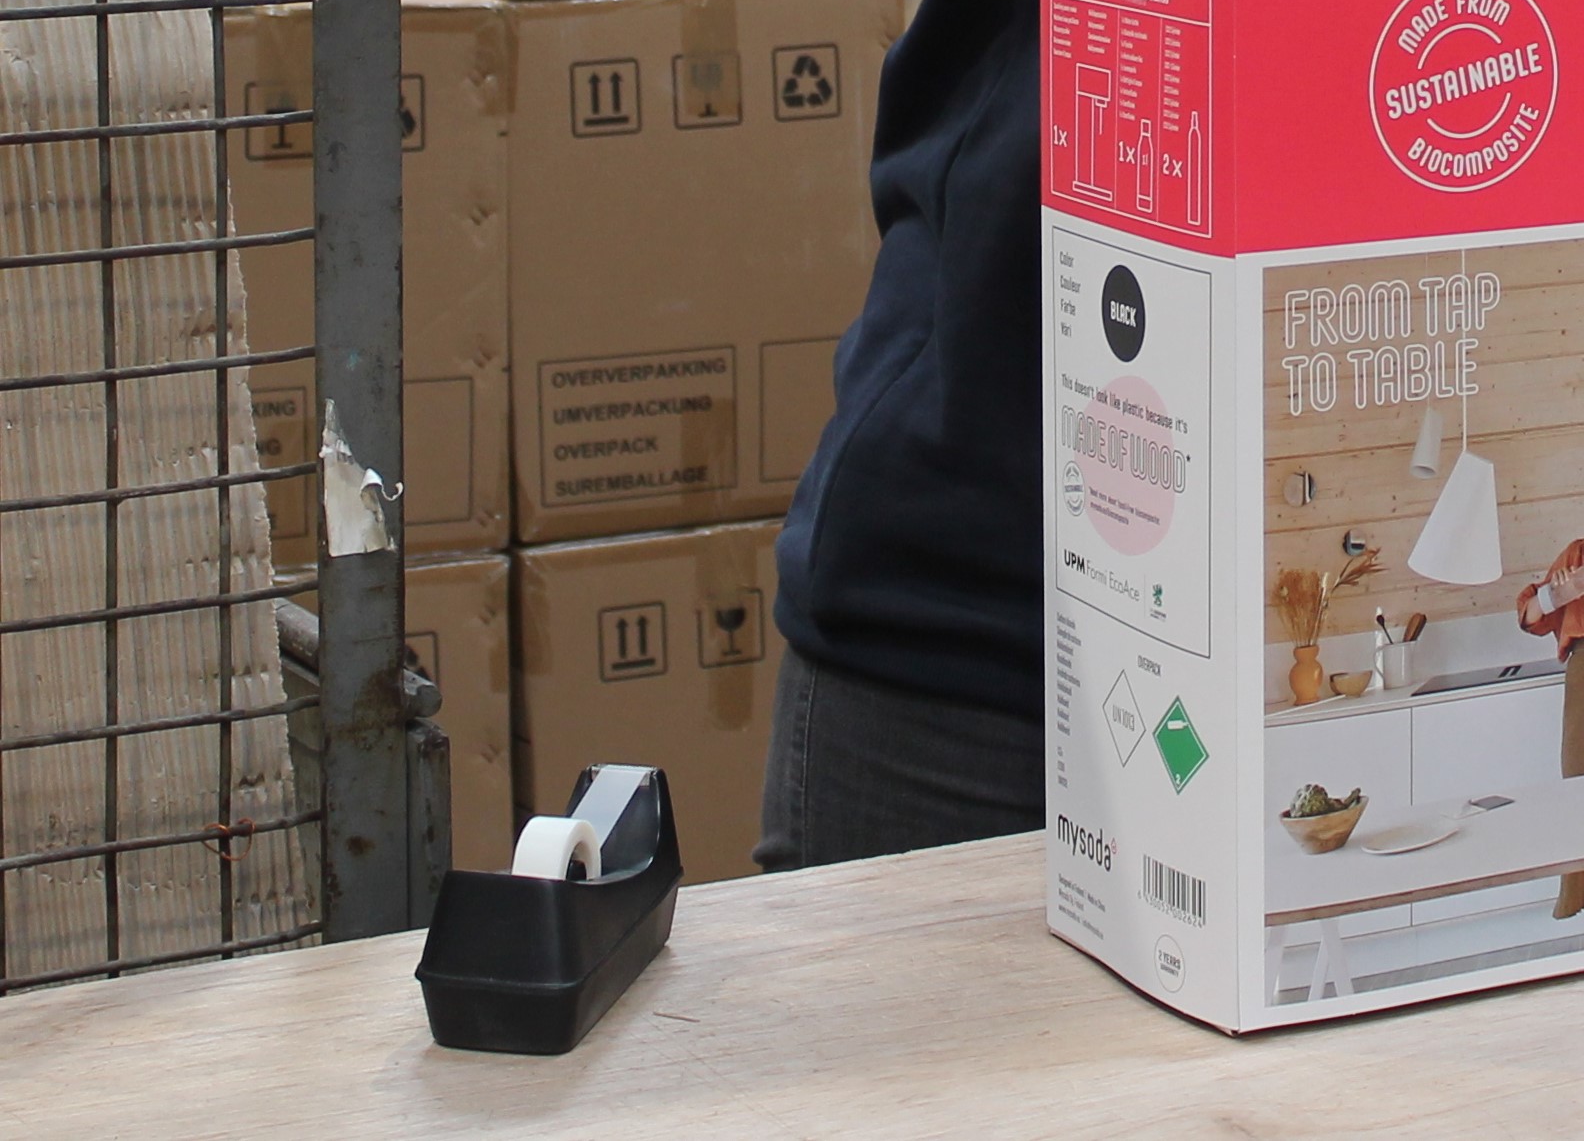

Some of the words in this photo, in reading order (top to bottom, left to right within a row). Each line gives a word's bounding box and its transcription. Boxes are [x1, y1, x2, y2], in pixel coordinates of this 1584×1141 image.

[1385, 42, 1543, 119] SUSTAINABLE
[1407, 102, 1540, 178] BIOCOMPOSITE
[1110, 300, 1137, 328] BLACK
[1285, 279, 1411, 349] FROM
[1418, 272, 1500, 337] TAP
[551, 357, 727, 389] OVERVERPAKKING
[1062, 373, 1073, 390] This
[1096, 387, 1108, 405] look
[1109, 391, 1121, 410] like
[1122, 398, 1144, 419] plastic
[1145, 406, 1173, 429] because
[1282, 352, 1336, 416] TO
[1347, 339, 1479, 409] TABLE
[552, 395, 713, 425] UMVERPACKUNG
[553, 435, 659, 461] OVERPACK
[1062, 405, 1107, 464] MADE
[1108, 425, 1128, 472] OF
[554, 465, 710, 497] SUREMBALLAGE
[1064, 549, 1086, 575] UPM
[1109, 571, 1140, 603] EcoAce
[1058, 813, 1112, 873] mysoda
